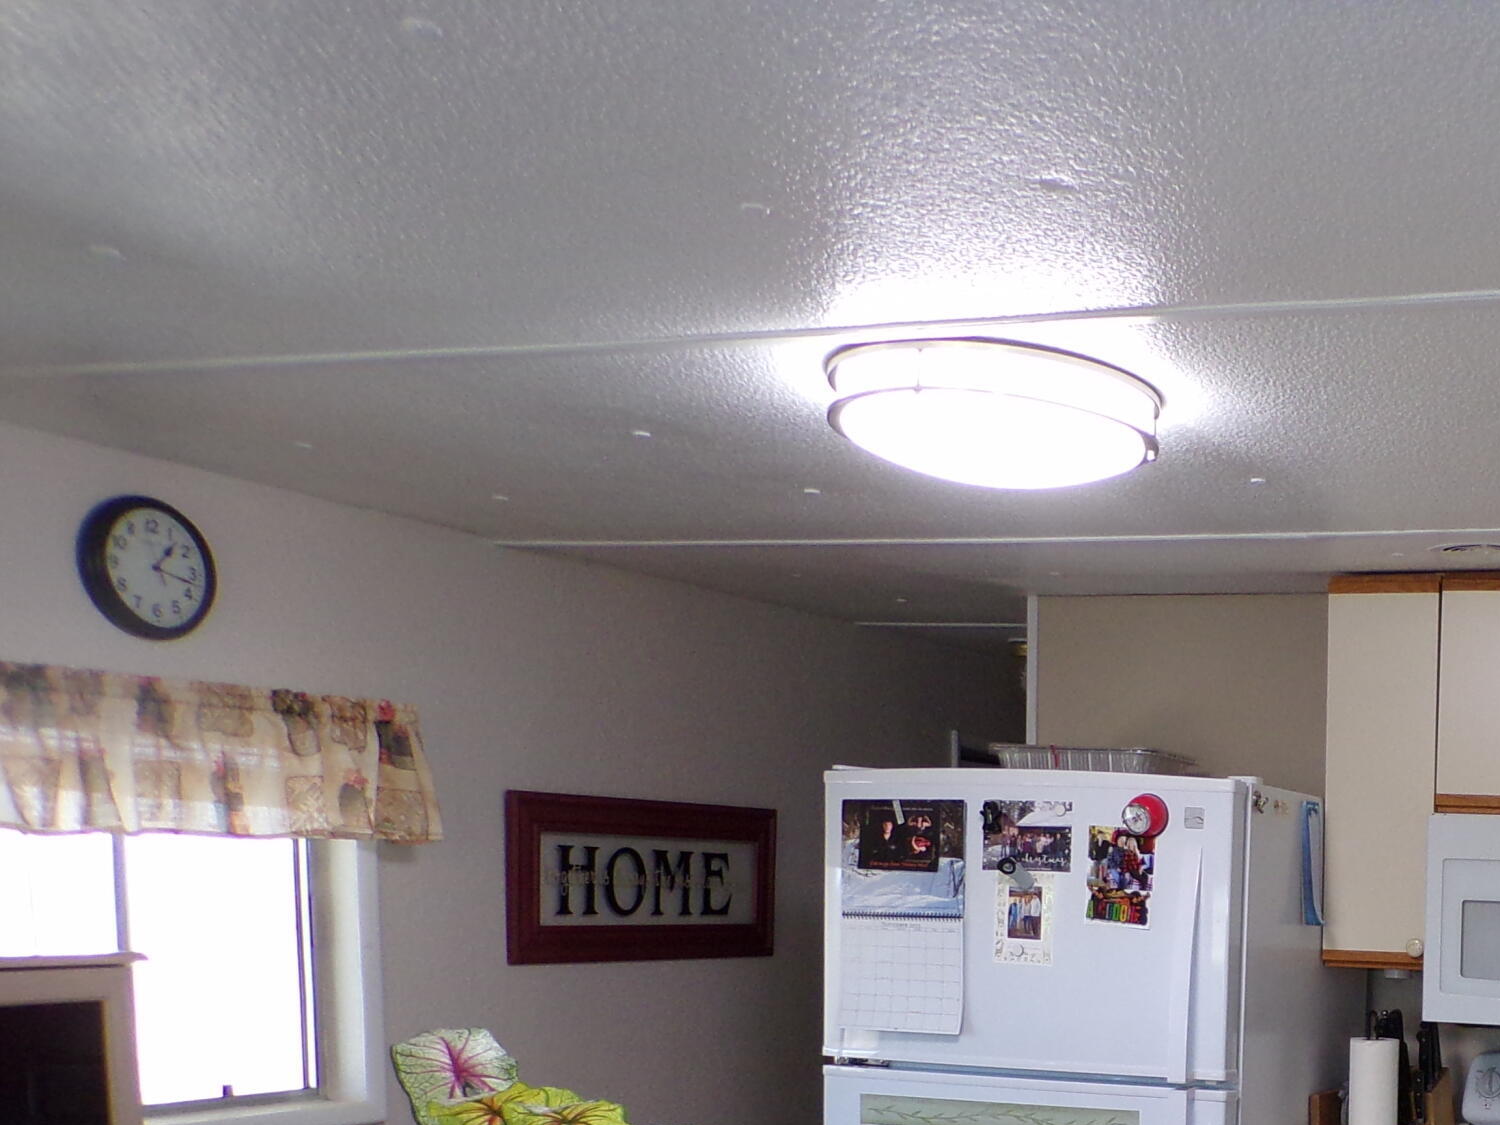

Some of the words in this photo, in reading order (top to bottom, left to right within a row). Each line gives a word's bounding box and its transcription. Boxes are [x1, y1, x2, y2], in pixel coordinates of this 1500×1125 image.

[145, 519, 159, 534] 12
[181, 544, 191, 559] 2
[184, 586, 193, 601] 4
[132, 594, 142, 609] 7
[171, 600, 181, 614] 5
[152, 603, 162, 618] 6
[556, 844, 732, 916] HOME
